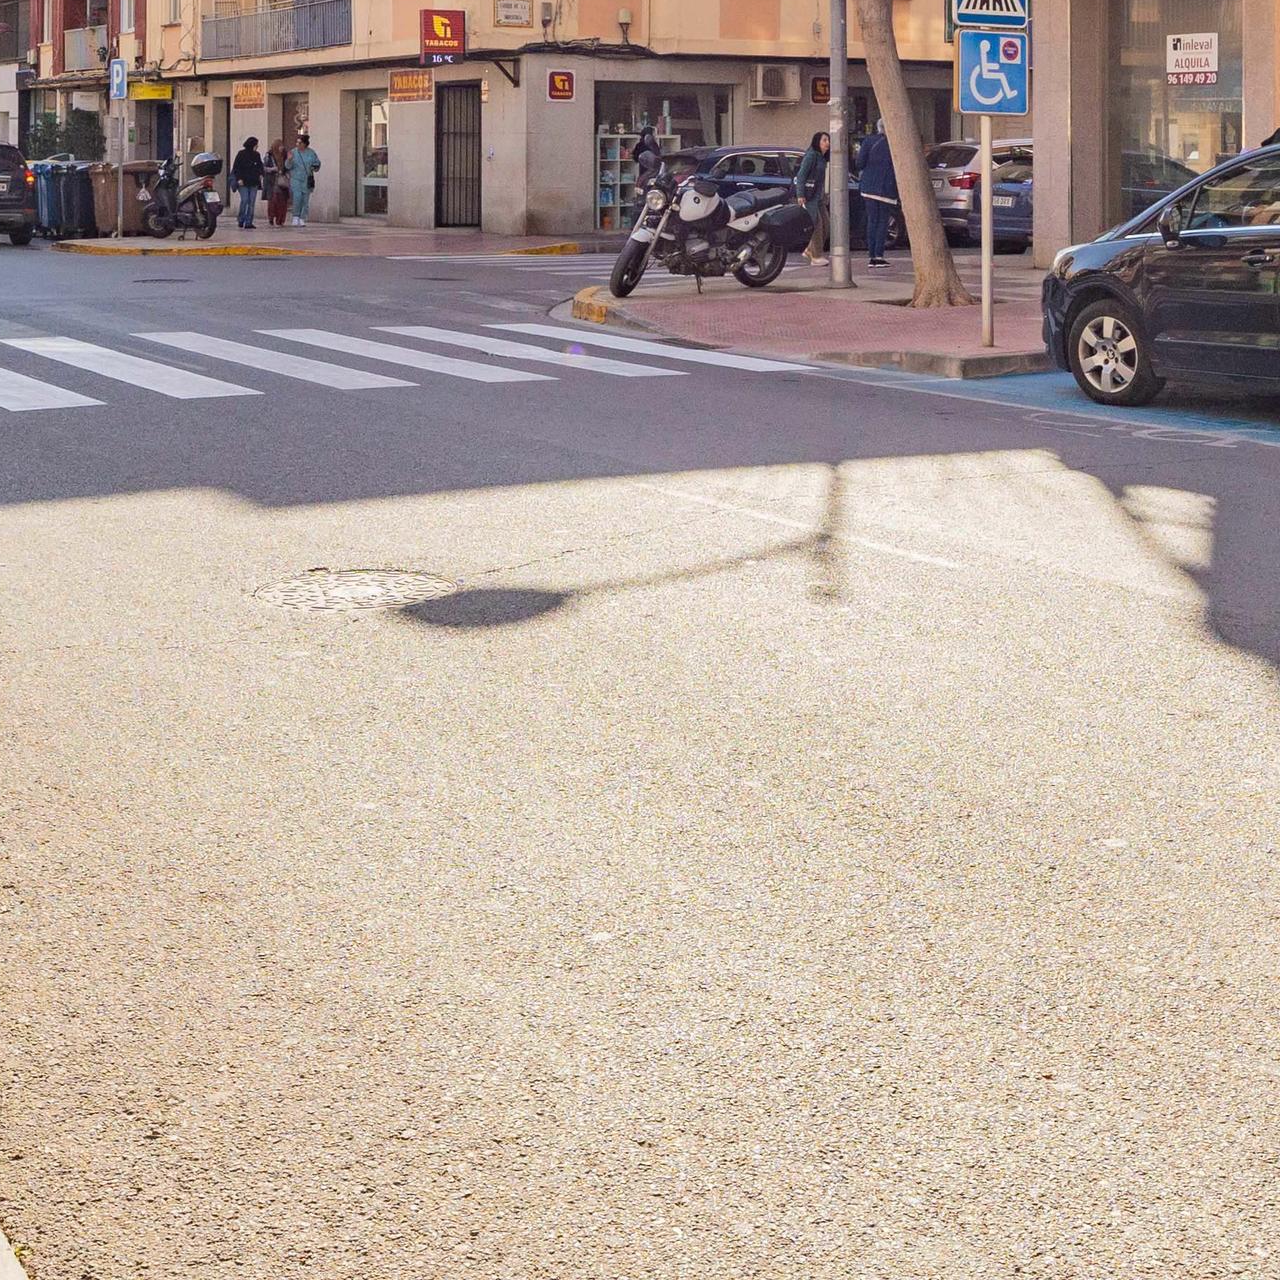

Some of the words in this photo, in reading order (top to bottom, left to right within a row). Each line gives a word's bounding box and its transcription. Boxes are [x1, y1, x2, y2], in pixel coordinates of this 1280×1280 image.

[424, 39, 459, 47] TABACOS
[1182, 38, 1213, 51] inleval
[432, 54, 443, 63] 16
[1174, 57, 1210, 70] ALQUILA
[393, 74, 430, 90] TABACOS
[1167, 74, 1178, 85] 96
[1178, 73, 1194, 85] 149
[1194, 73, 1206, 84] 49
[1206, 73, 1217, 84] 20
